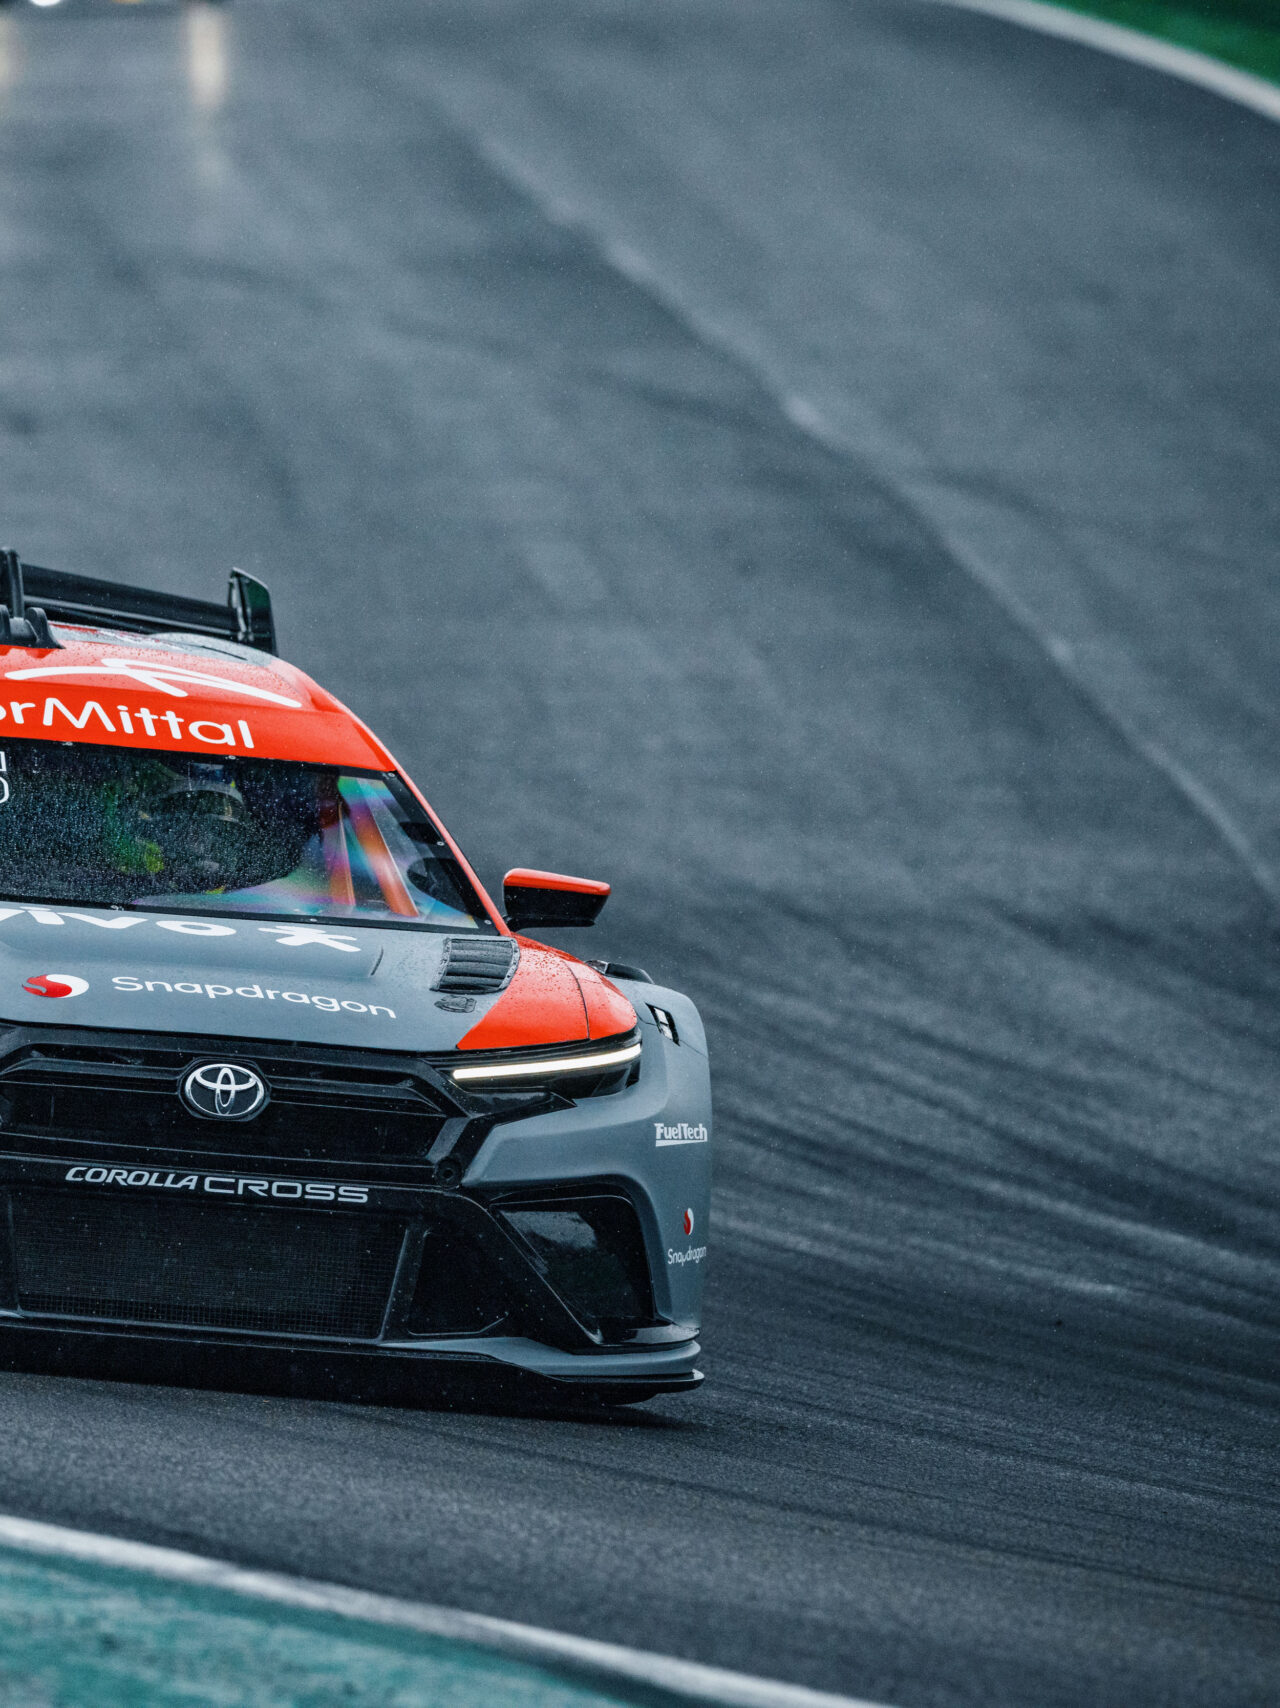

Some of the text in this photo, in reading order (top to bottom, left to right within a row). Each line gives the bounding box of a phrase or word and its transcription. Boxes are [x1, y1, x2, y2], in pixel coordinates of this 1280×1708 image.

[112, 977, 397, 1019] Snapdragon
[654, 1123, 708, 1143] FuelTech
[66, 1166, 369, 1204] COROLLA CROSS
[667, 1245, 707, 1268] Snapdragon
